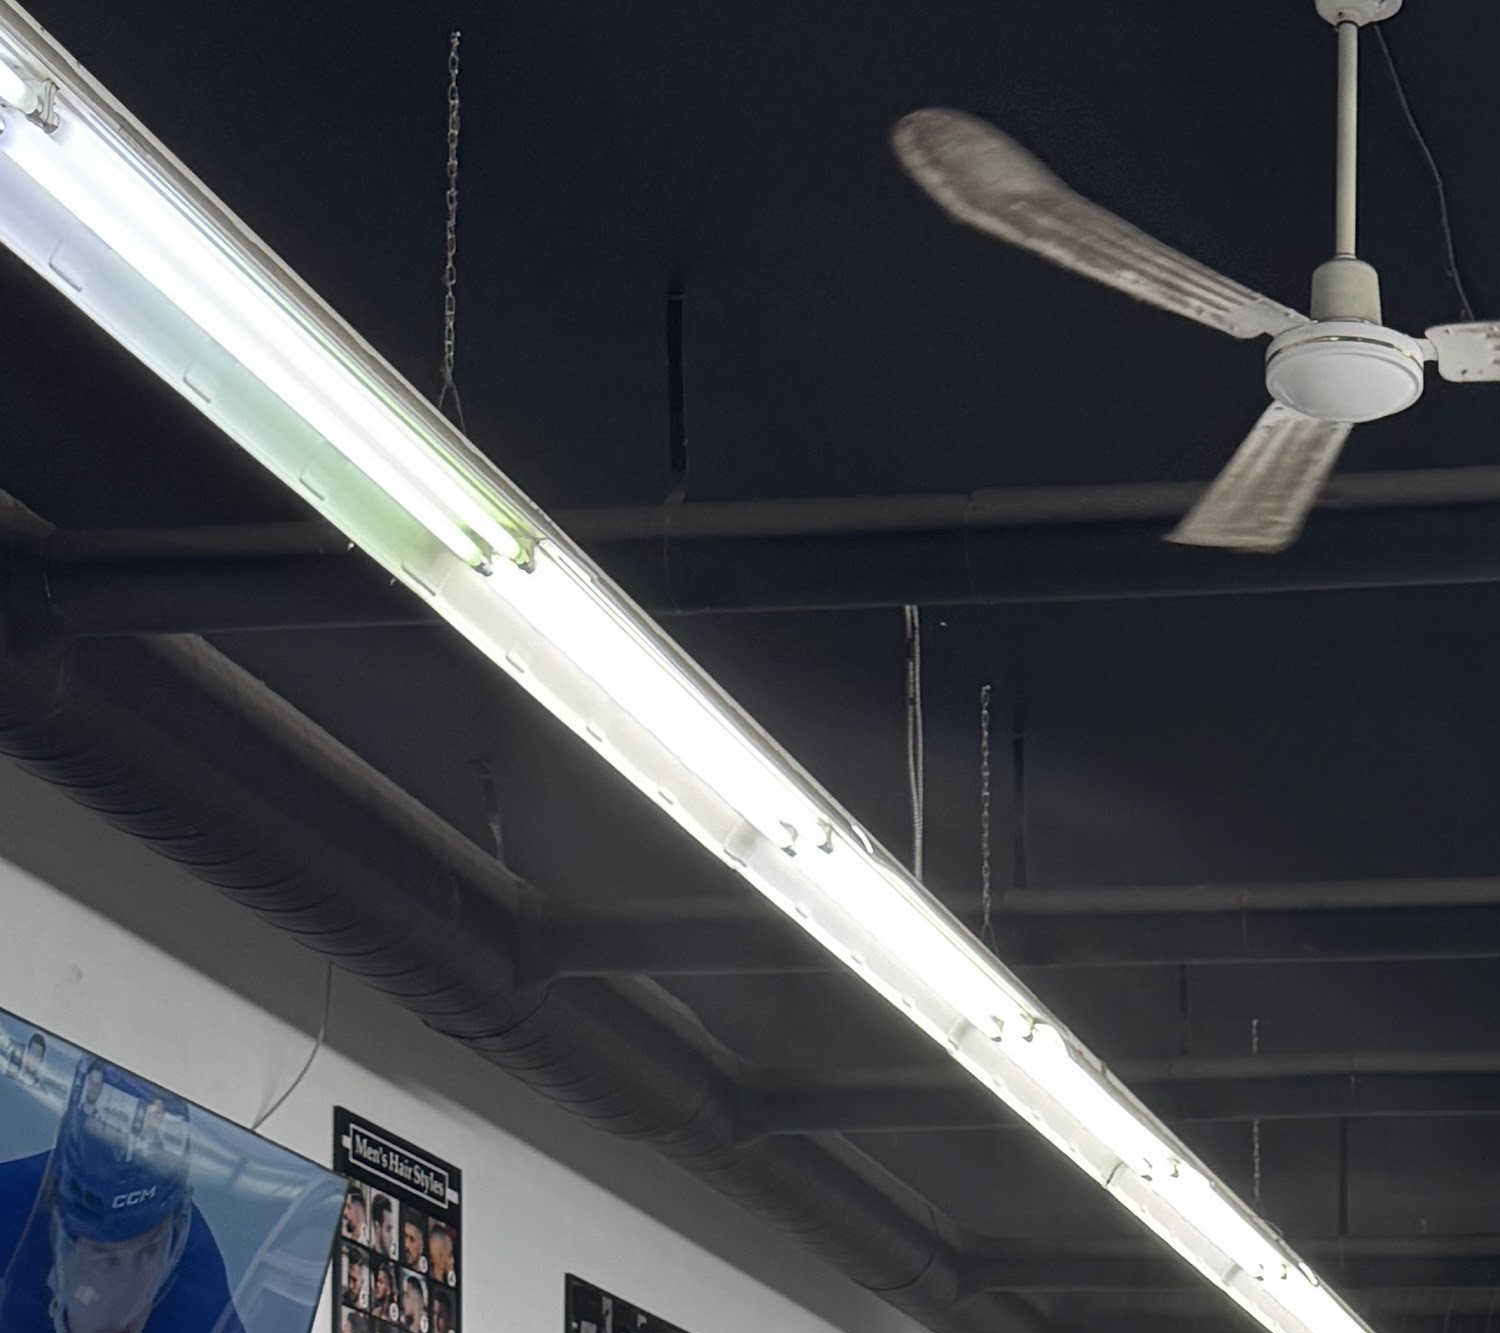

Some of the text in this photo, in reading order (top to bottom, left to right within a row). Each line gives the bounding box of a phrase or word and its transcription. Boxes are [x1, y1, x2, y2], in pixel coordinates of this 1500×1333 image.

[354, 1133, 445, 1196] Men's Hair Styles
[112, 1186, 157, 1209] CCM
